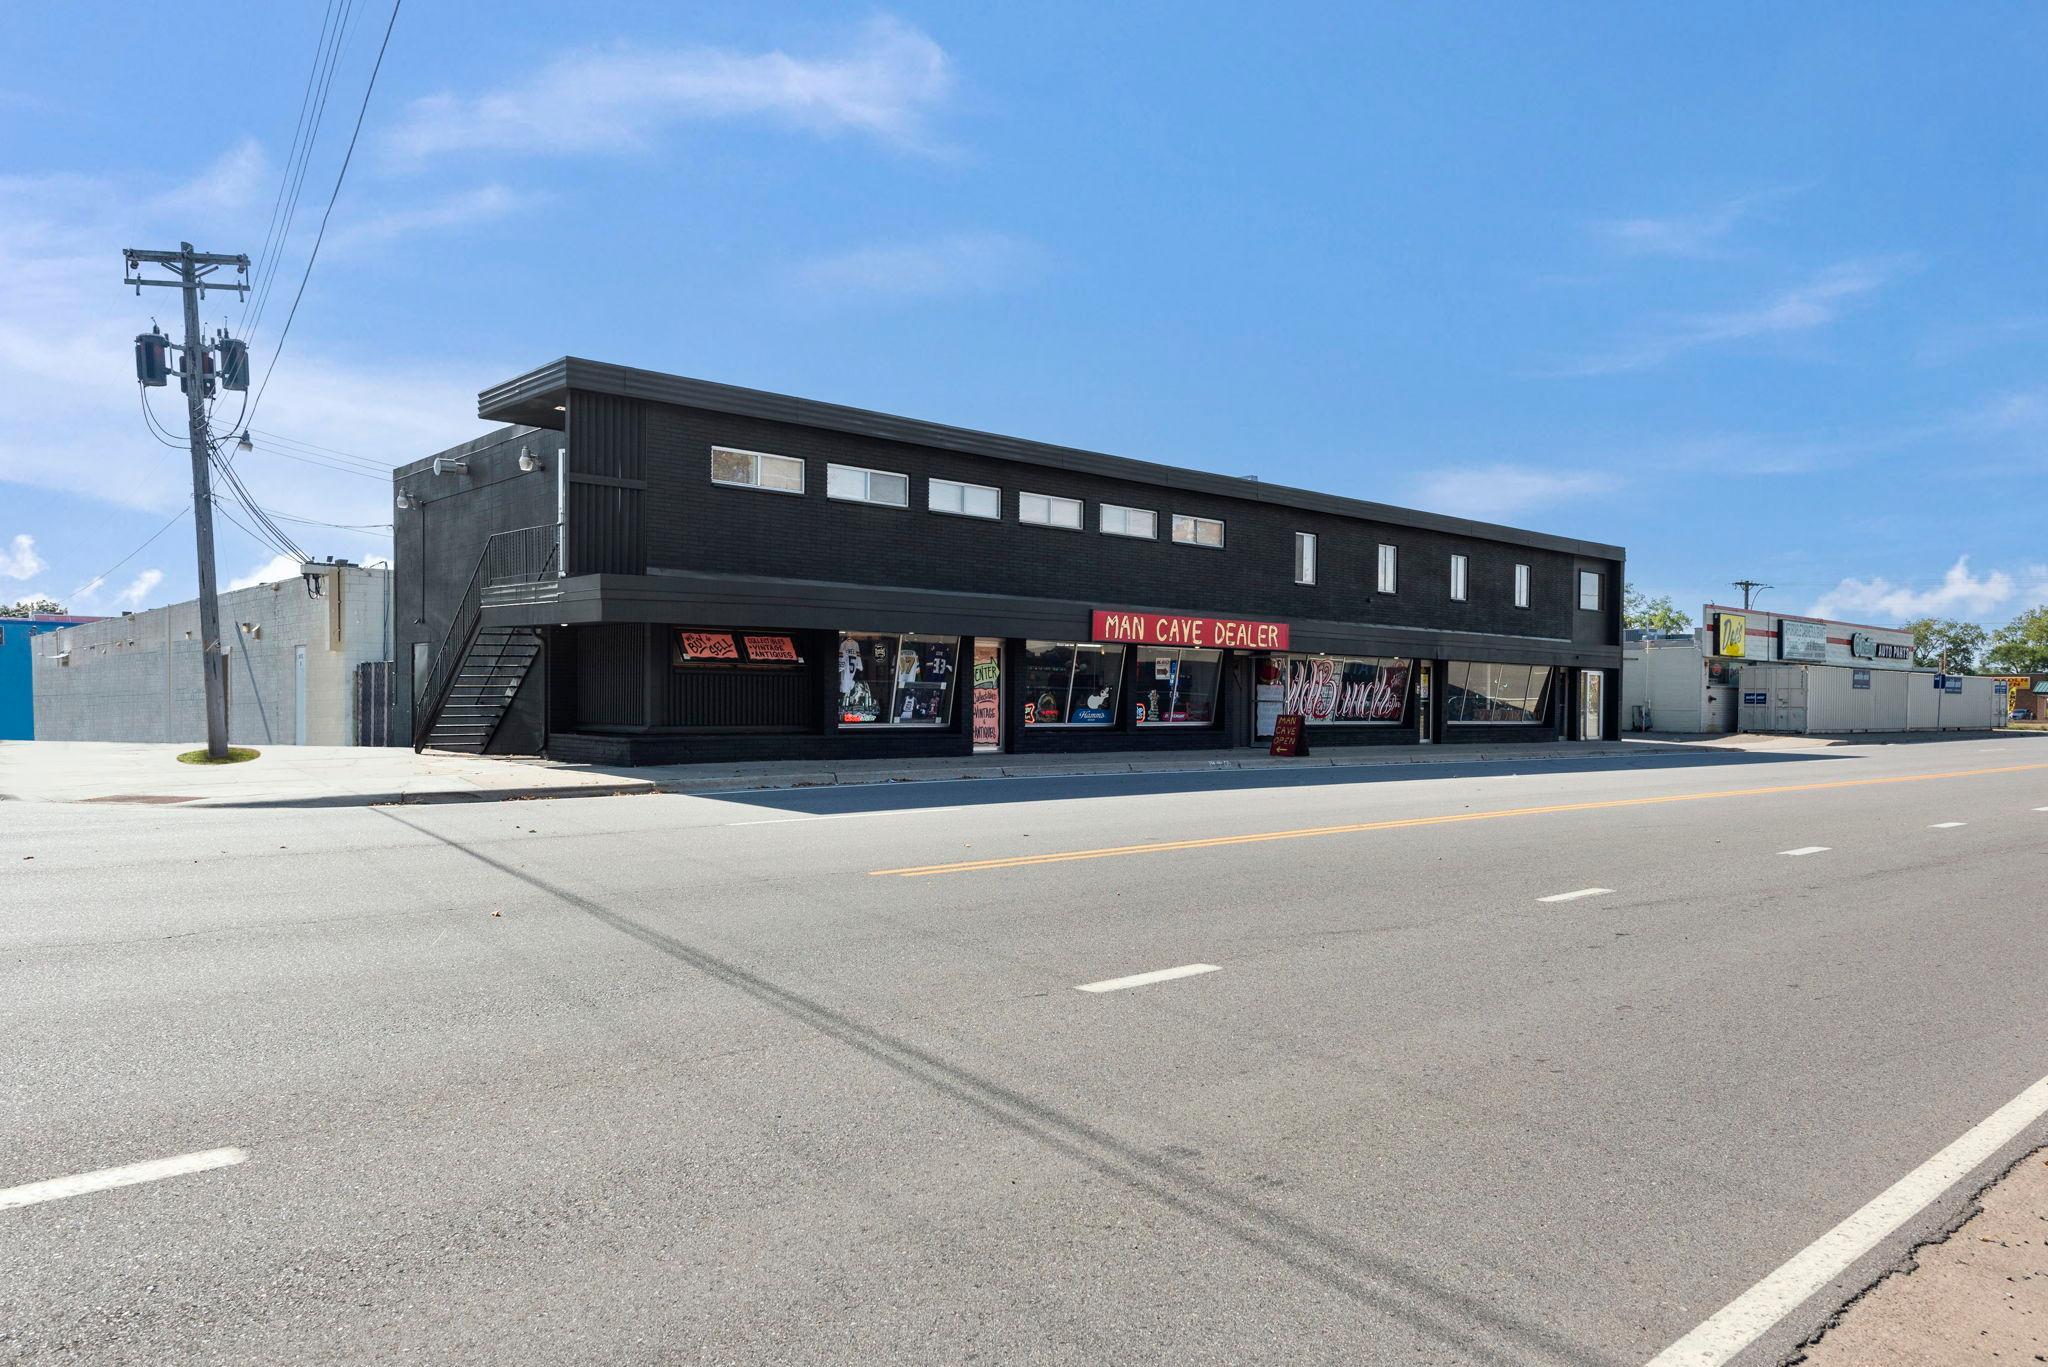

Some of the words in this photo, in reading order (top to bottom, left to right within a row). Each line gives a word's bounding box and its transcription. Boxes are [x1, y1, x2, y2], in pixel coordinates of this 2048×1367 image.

[1105, 614, 1145, 640] MAN
[1156, 618, 1203, 644] CAVE
[1214, 622, 1278, 647] DEALER
[688, 635, 707, 654] BUY
[708, 638, 733, 656] SELL
[752, 644, 785, 652] VINTAGE
[755, 651, 794, 659] ANTIQUES
[1878, 644, 1893, 658] AUTO
[1893, 646, 1909, 659] PARTS
[933, 658, 946, 674] 33
[975, 665, 997, 682] ENTER
[974, 707, 996, 719] VINTAGE
[1278, 716, 1297, 725] MAN
[974, 727, 997, 740] ANTIQUES
[1275, 727, 1297, 736] CAVE
[1272, 736, 1296, 745] OPEN
